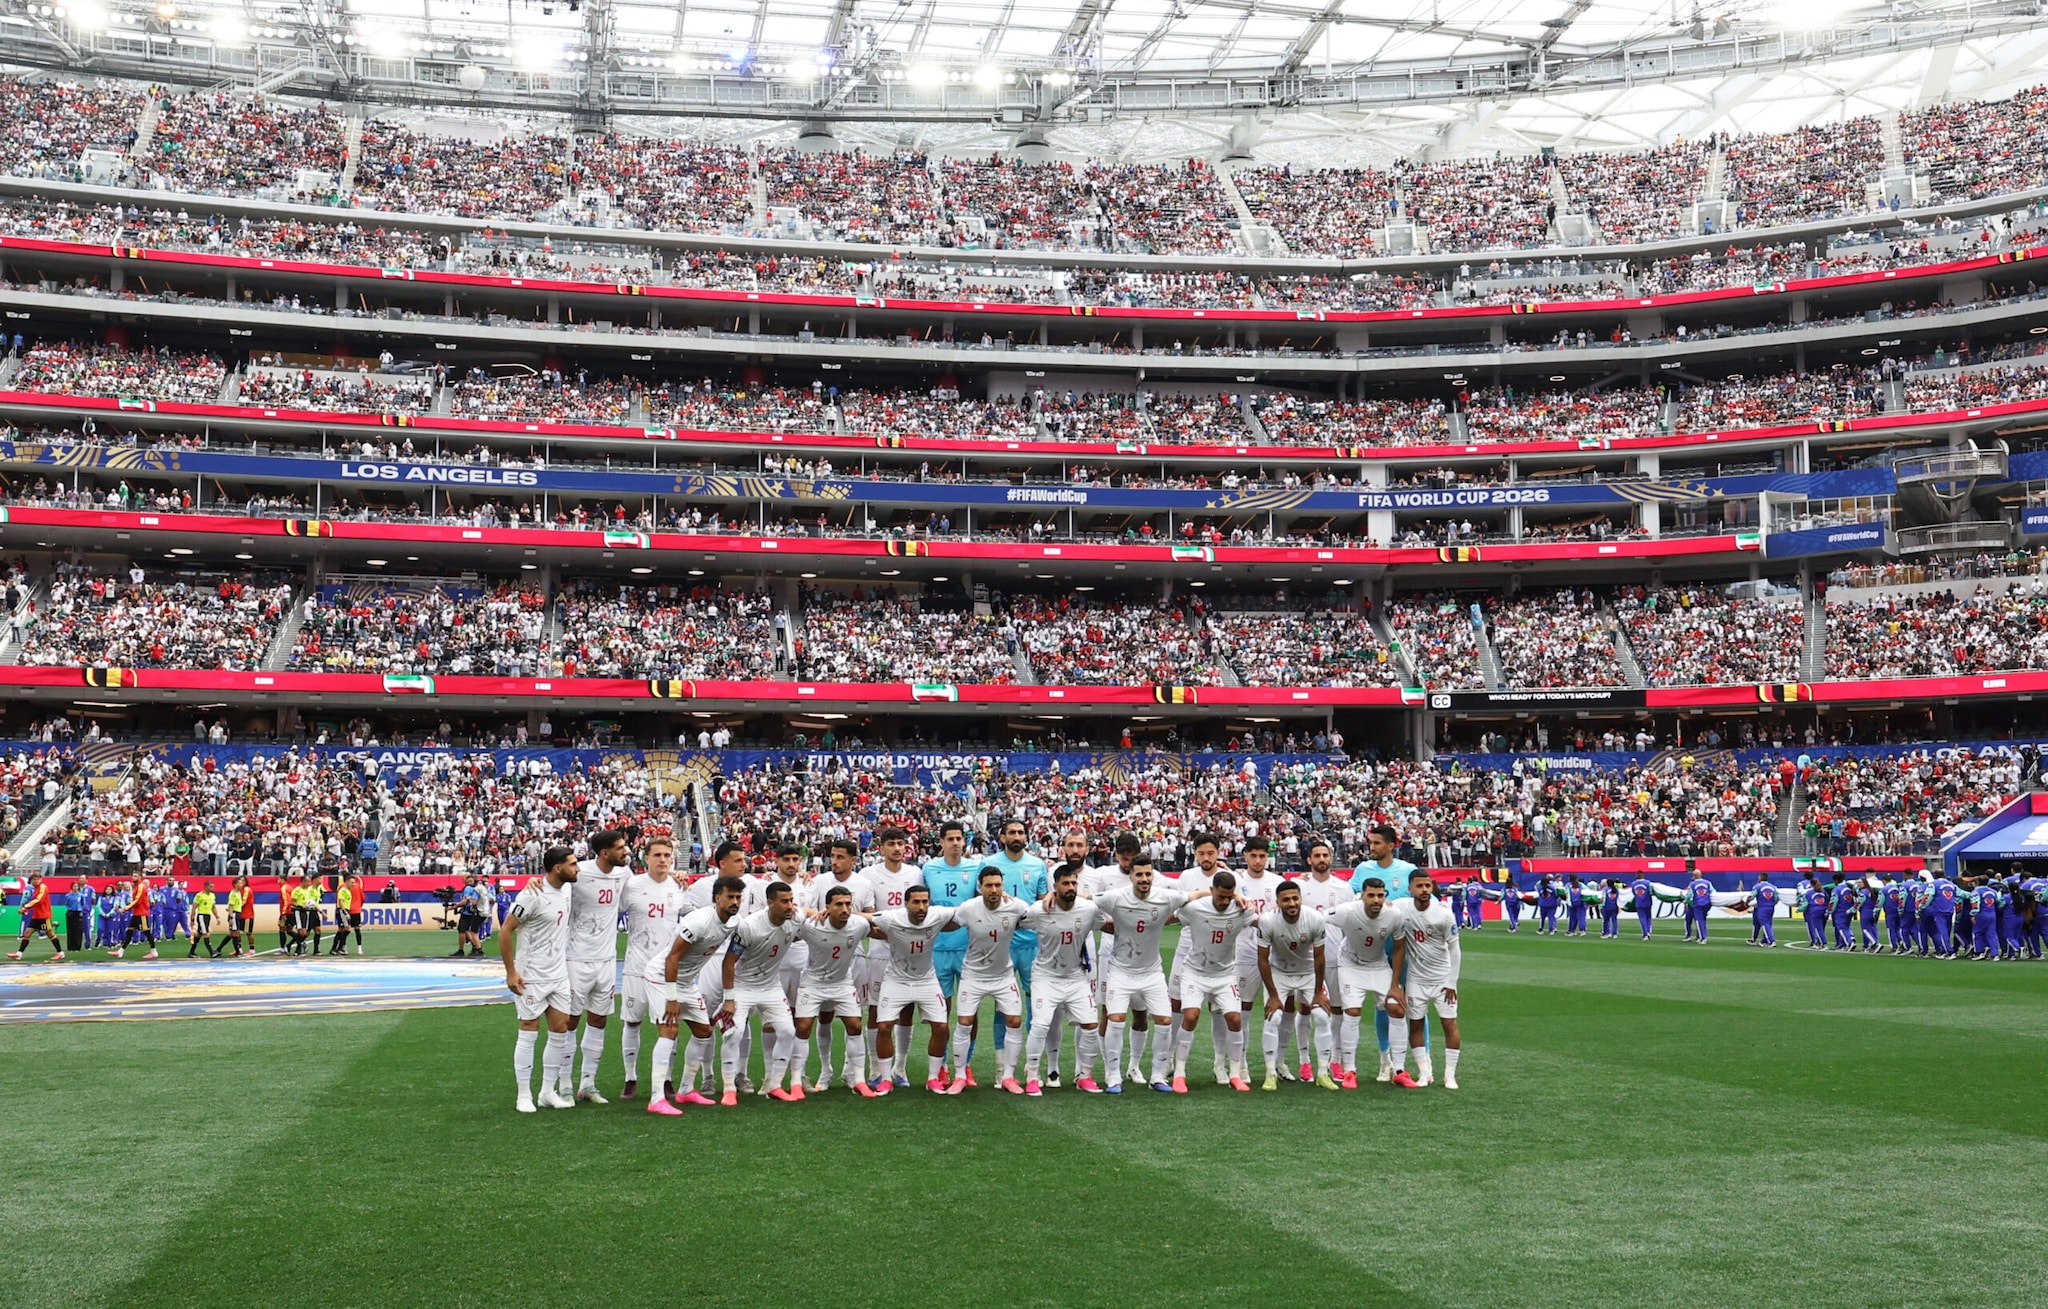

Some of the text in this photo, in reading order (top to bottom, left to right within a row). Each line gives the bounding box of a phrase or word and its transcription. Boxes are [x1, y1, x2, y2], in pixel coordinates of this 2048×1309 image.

[341, 463, 538, 485] LOS ANGELES
[1006, 488, 1088, 504] #FIFAWorldCup
[1358, 489, 1550, 507] FIFA WORLD CUP 2026
[1828, 530, 1879, 543] #FIFAWorldCup
[1511, 693, 1532, 701] READY
[1533, 693, 1547, 701] FOR
[599, 889, 613, 904] 20
[945, 883, 957, 897] 12
[1012, 884, 1017, 897] 1
[887, 891, 903, 906] 26
[648, 903, 664, 918] 24
[556, 911, 564, 926] 7
[1136, 921, 1145, 933] 6
[988, 930, 998, 943] 4
[1061, 931, 1073, 945] 13
[1211, 930, 1224, 944] 19
[1364, 936, 1374, 947] 9
[768, 944, 780, 958] 3
[832, 946, 841, 959] 2
[910, 941, 924, 954] 14
